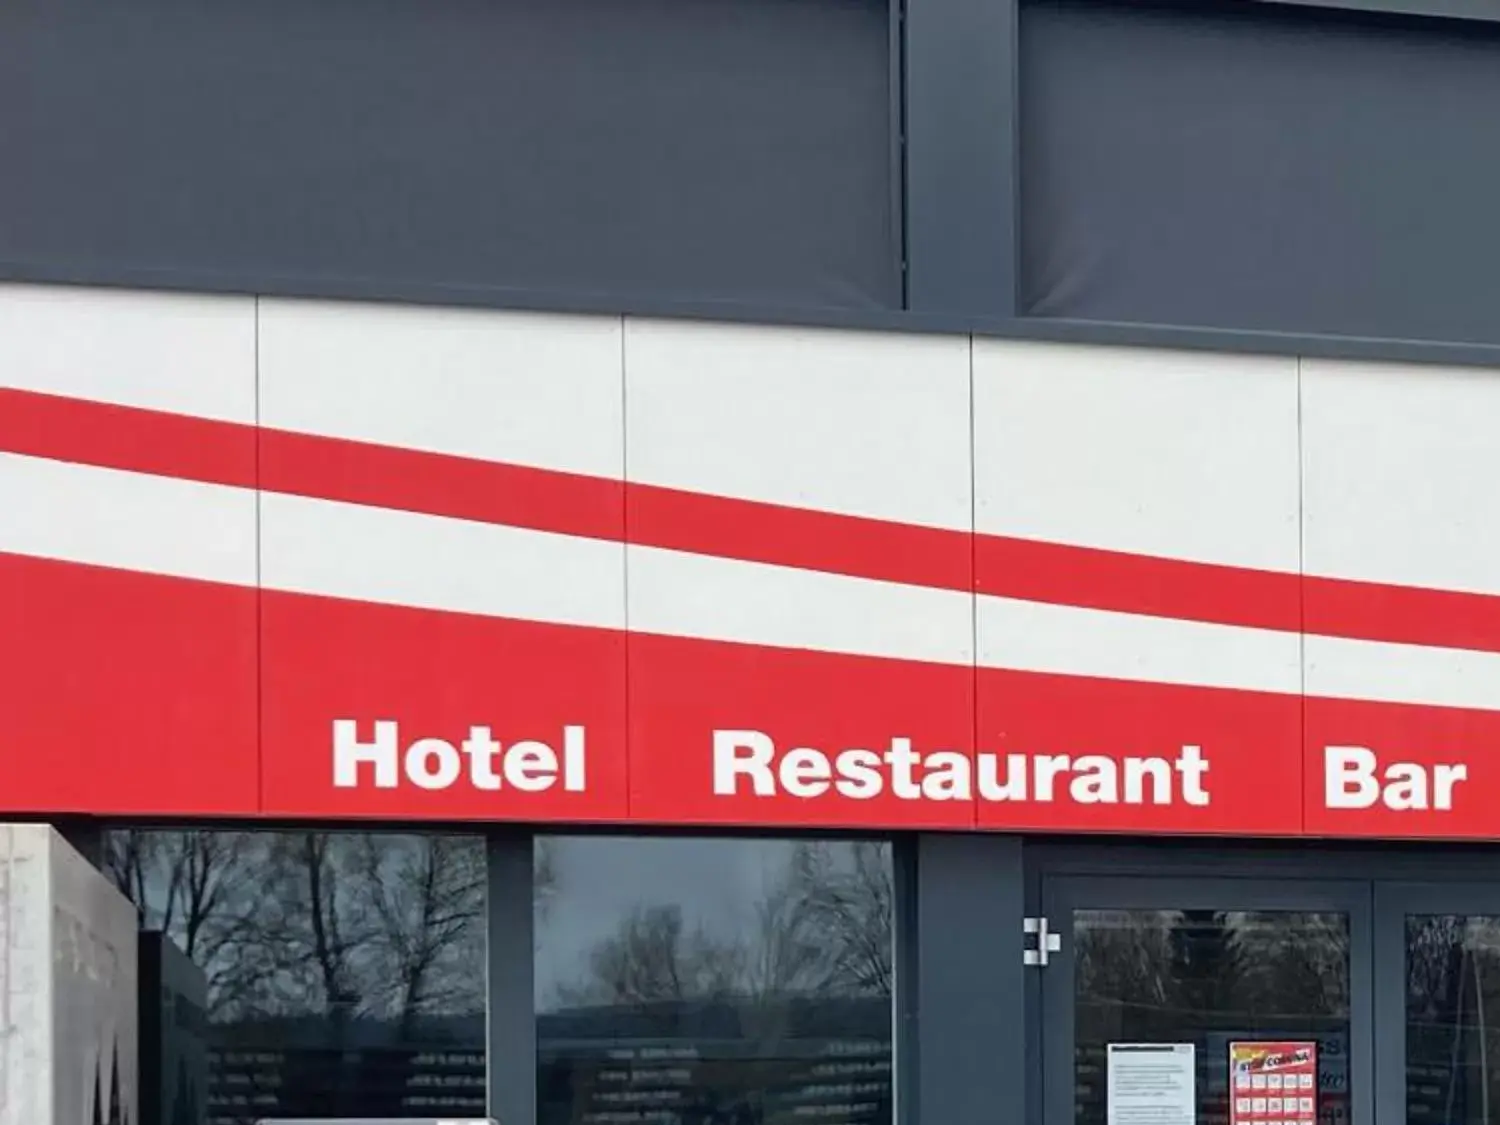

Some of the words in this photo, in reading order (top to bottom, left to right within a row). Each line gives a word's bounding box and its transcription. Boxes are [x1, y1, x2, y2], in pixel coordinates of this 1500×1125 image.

[333, 719, 585, 793] Hotel
[713, 729, 1209, 806] Restaurant
[1324, 746, 1467, 811] Bar
